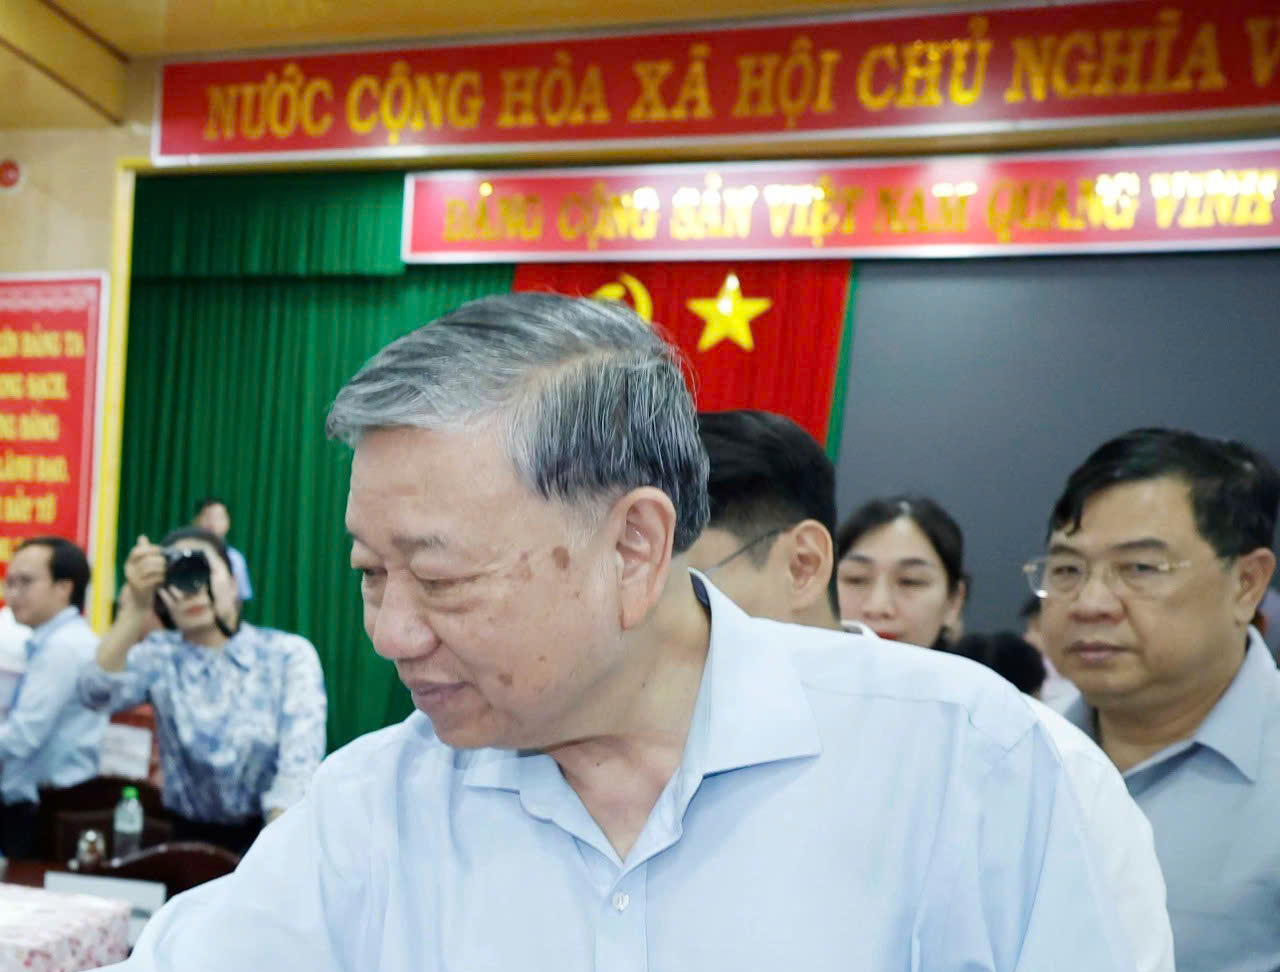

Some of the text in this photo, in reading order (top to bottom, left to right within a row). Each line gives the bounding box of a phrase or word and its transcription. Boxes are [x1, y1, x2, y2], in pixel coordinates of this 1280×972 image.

[346, 59, 485, 145] CỘNG
[498, 51, 609, 128] HÒA
[629, 44, 712, 121] XÃ
[733, 35, 839, 128] HỘI
[856, 17, 992, 110] CHỦ
[1004, 10, 1225, 104] NGHĨA
[558, 180, 658, 250] CỘNG
[671, 171, 758, 240] SẢN
[763, 175, 863, 247] VIỆT
[877, 182, 978, 234] NAM
[986, 176, 1140, 243] QUANG
[1150, 168, 1278, 230] VINH
